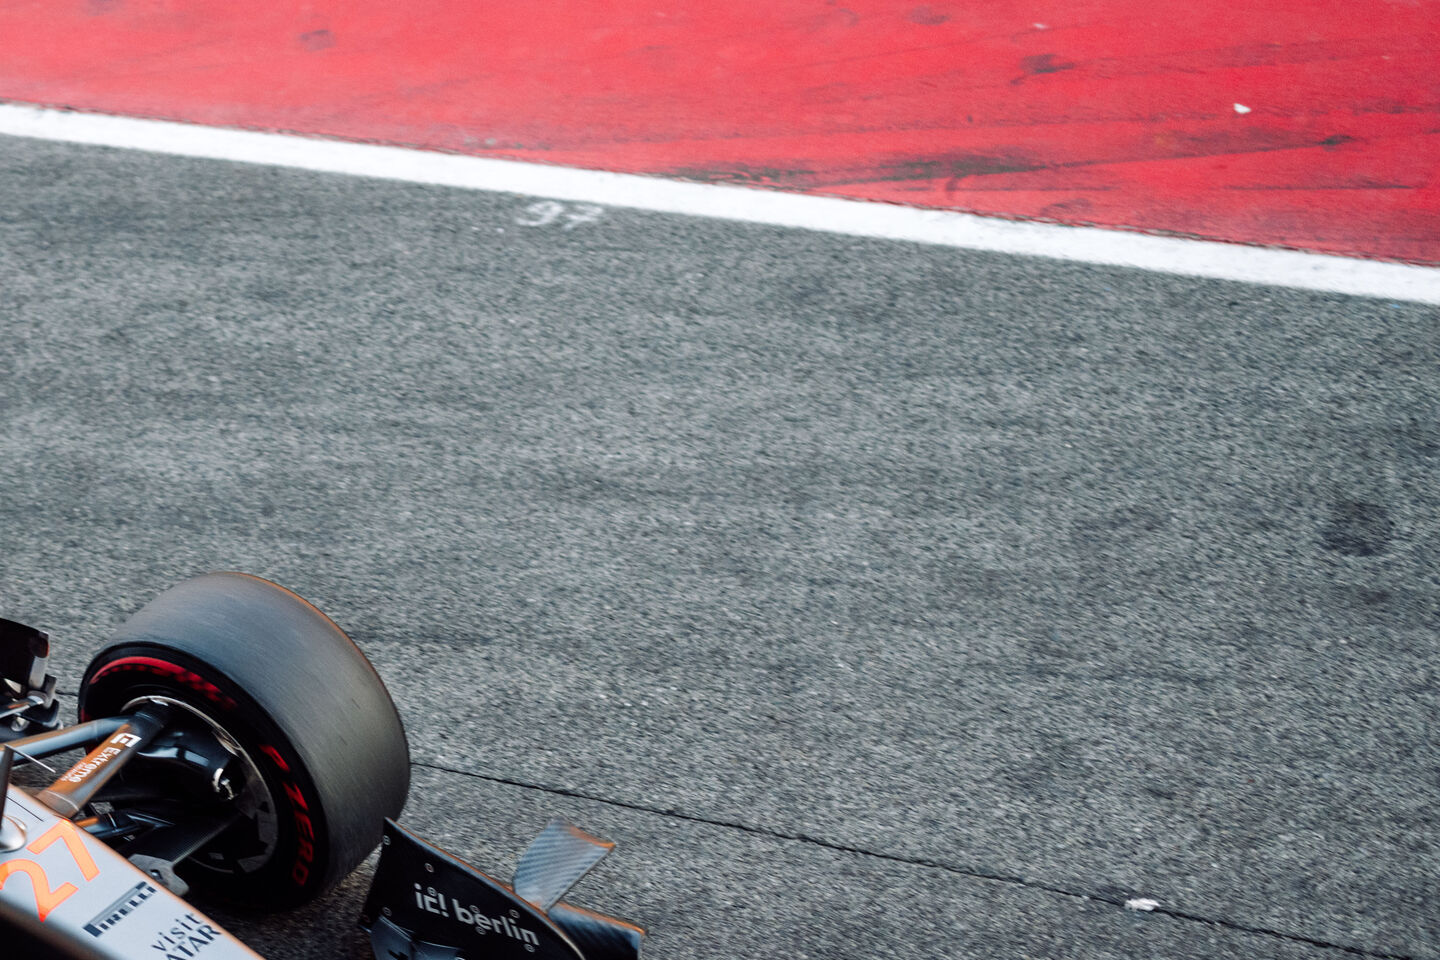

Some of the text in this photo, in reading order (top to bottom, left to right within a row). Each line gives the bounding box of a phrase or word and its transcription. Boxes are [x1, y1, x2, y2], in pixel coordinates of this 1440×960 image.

[68, 746, 122, 783] Extreme
[282, 782, 315, 887] ZERO
[83, 881, 157, 938] PIRELLI
[151, 913, 204, 952] visit
[452, 898, 540, 946] berlin
